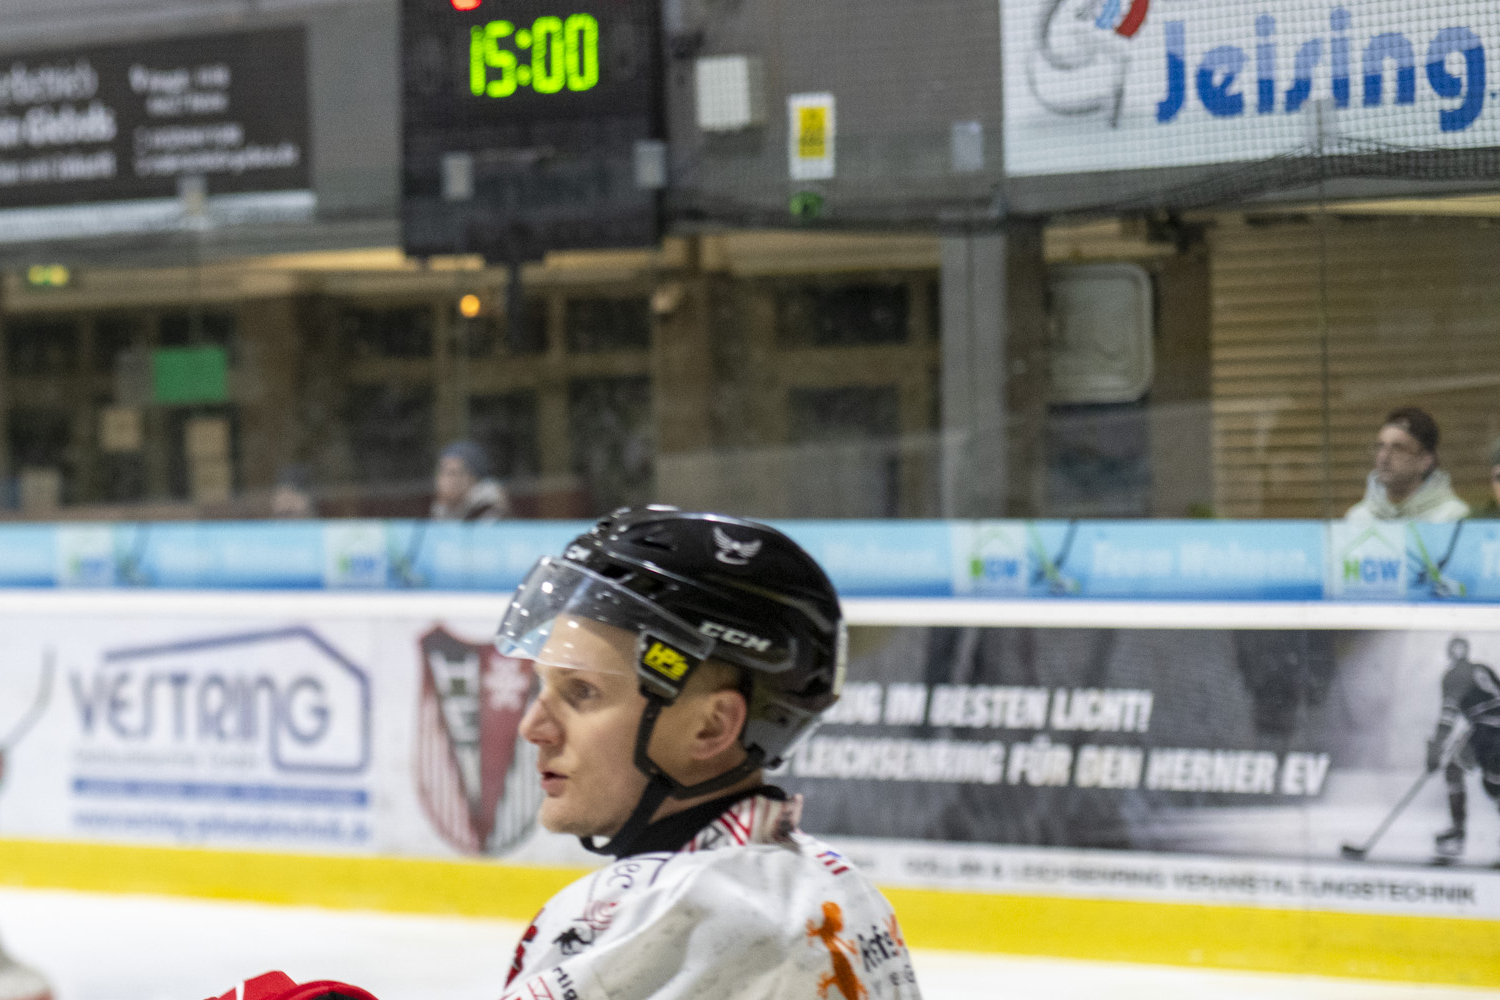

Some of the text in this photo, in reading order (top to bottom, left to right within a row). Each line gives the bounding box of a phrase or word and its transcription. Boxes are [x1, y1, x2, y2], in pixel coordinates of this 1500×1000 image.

[469, 13, 599, 98] 15:00
[699, 621, 772, 652] CCM
[69, 667, 332, 748] VESTRING
